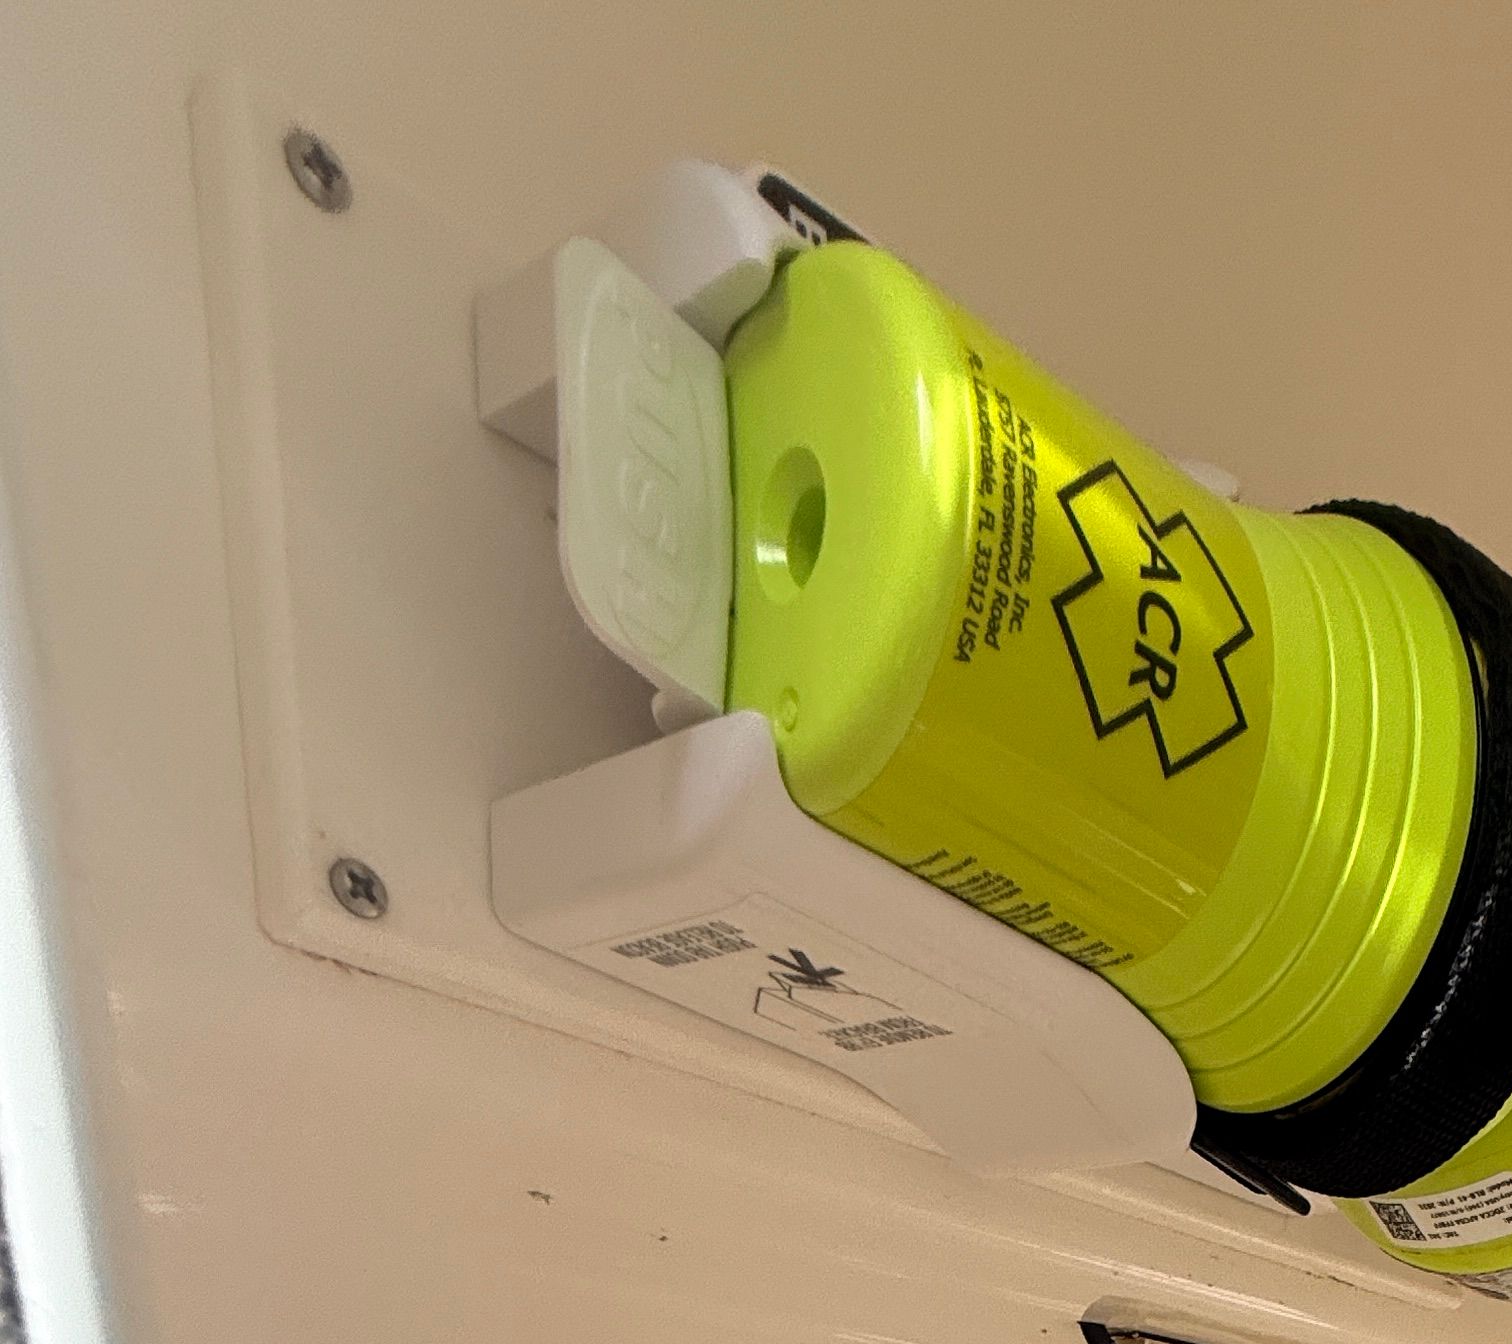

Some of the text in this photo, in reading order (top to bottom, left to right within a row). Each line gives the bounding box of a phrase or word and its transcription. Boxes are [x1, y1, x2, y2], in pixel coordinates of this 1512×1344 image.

[973, 376, 995, 497] Lauderdale,
[1017, 415, 1036, 462] ACR
[978, 506, 995, 532] FL
[996, 446, 1017, 588] Ravenswood
[1015, 462, 1038, 584] Electronics,
[967, 539, 992, 615] 33312
[1128, 523, 1182, 701] ACR
[954, 617, 979, 664] USA
[984, 587, 1009, 651] Road
